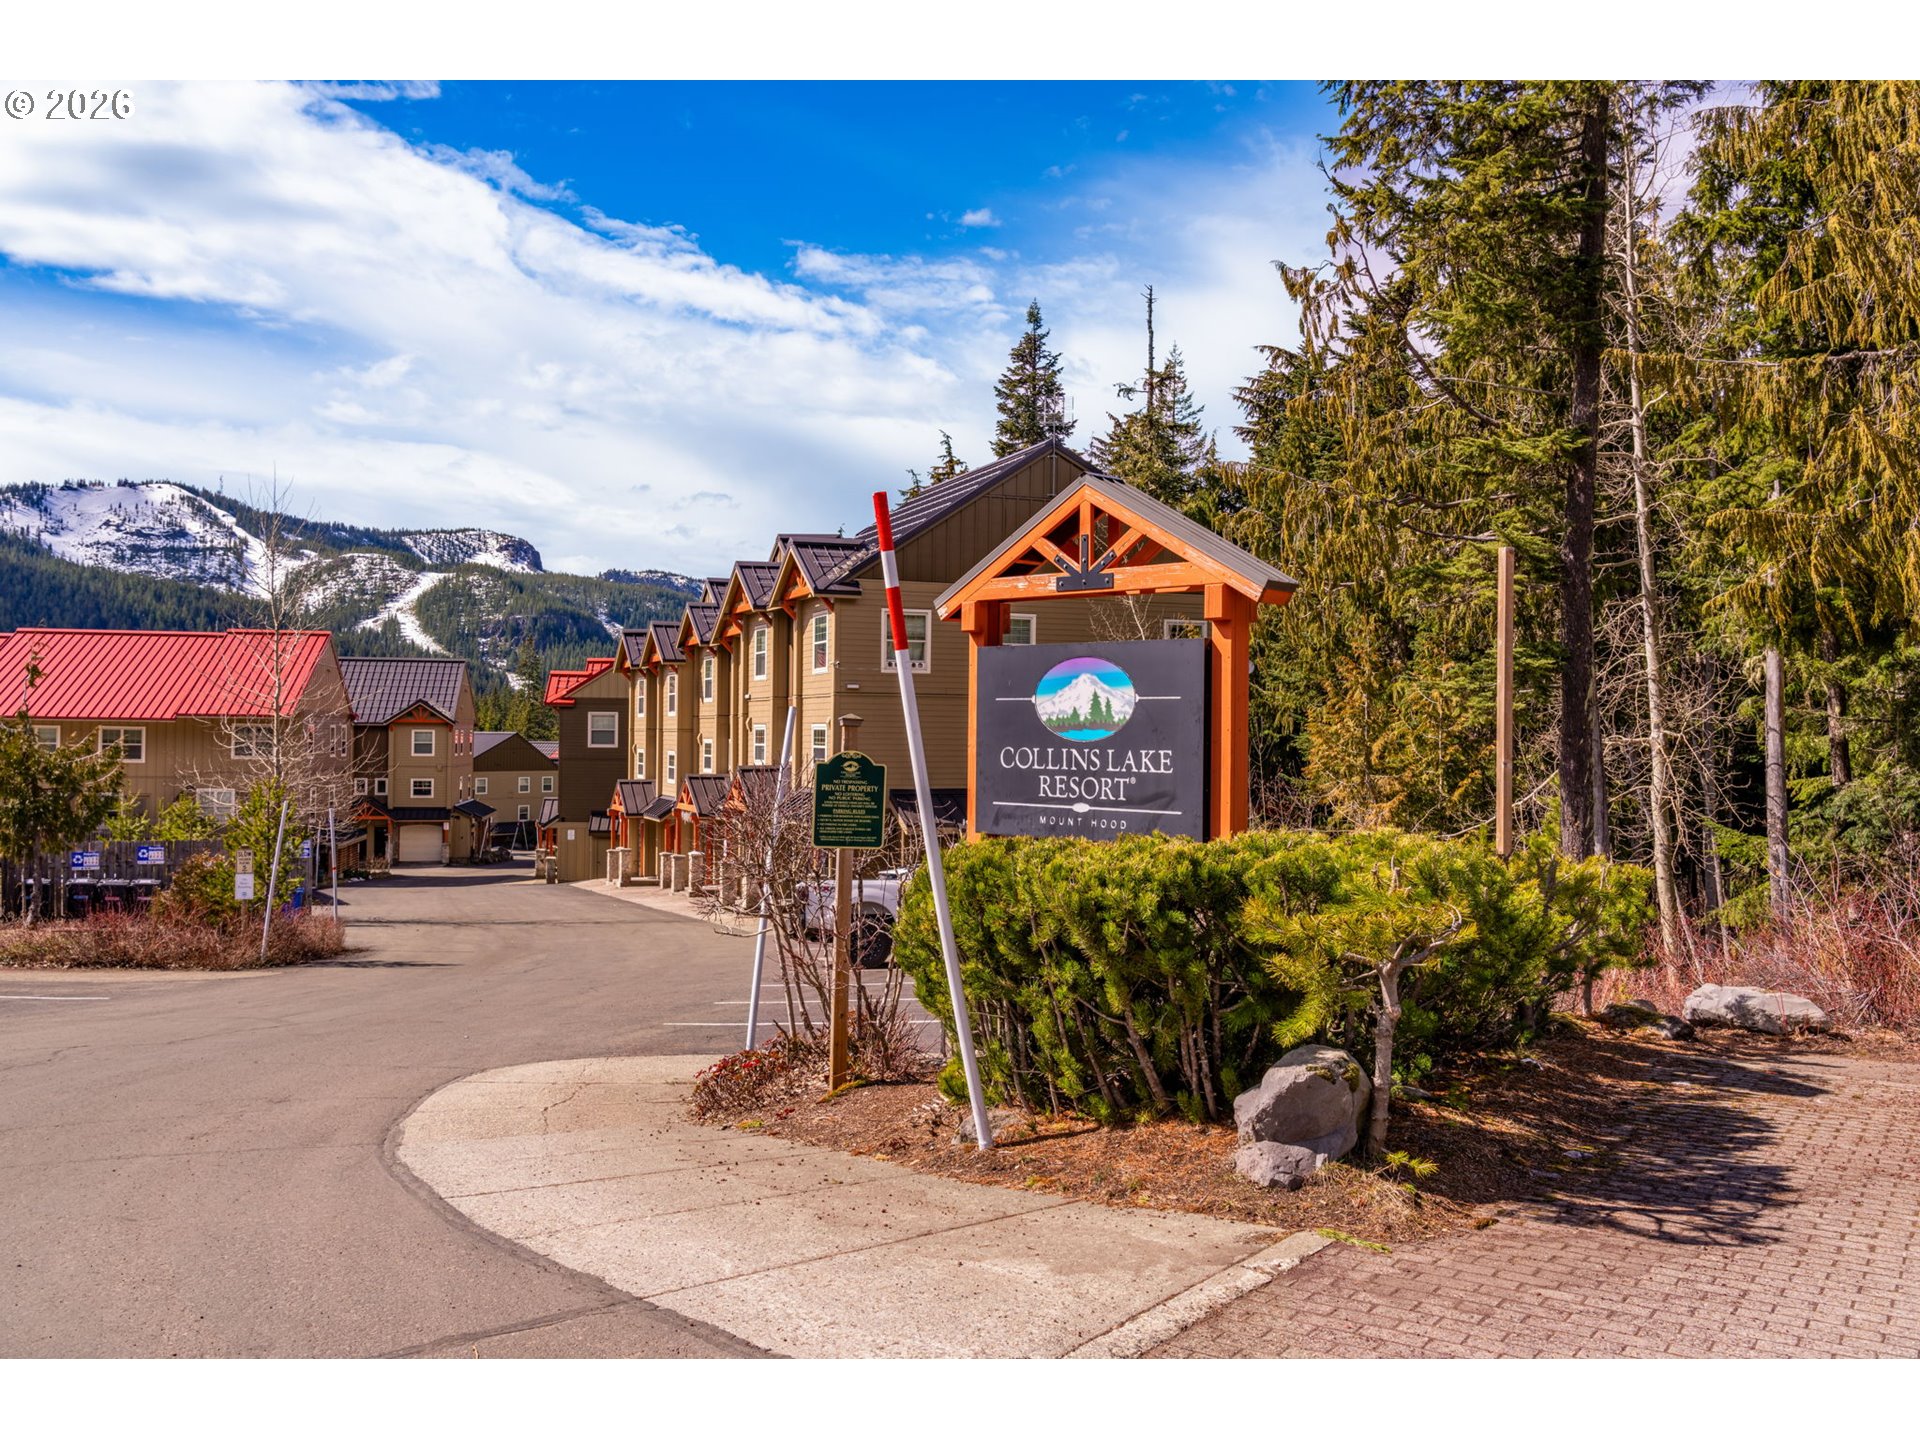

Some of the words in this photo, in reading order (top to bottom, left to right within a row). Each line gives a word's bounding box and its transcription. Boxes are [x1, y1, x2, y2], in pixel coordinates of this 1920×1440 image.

[1000, 746, 1100, 771] COLLINS
[1106, 749, 1174, 774] LAKE
[1039, 815, 1083, 827] MOUNT
[1091, 818, 1127, 829] HOOD
